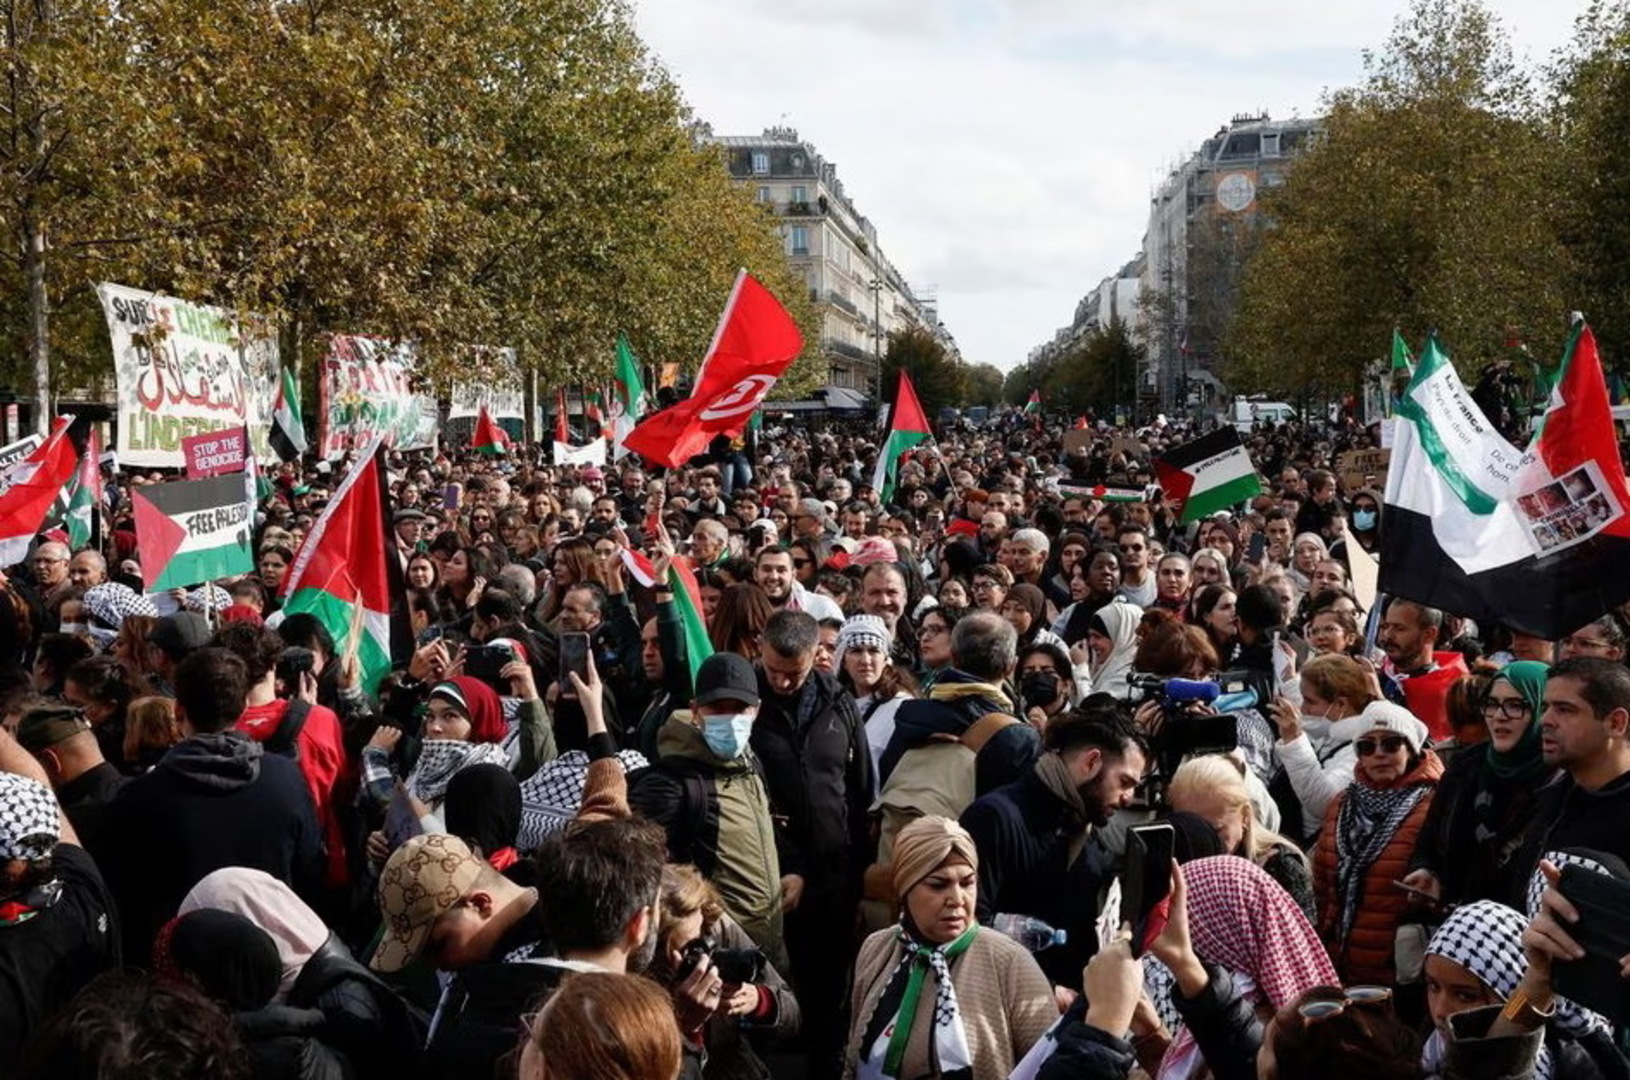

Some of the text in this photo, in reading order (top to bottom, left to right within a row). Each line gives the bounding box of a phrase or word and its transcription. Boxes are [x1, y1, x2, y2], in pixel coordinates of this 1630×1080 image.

[1453, 392, 1485, 434] France
[193, 436, 241, 458] STOP THE
[195, 450, 244, 471] GENOCIDE
[185, 512, 216, 539] FREE
